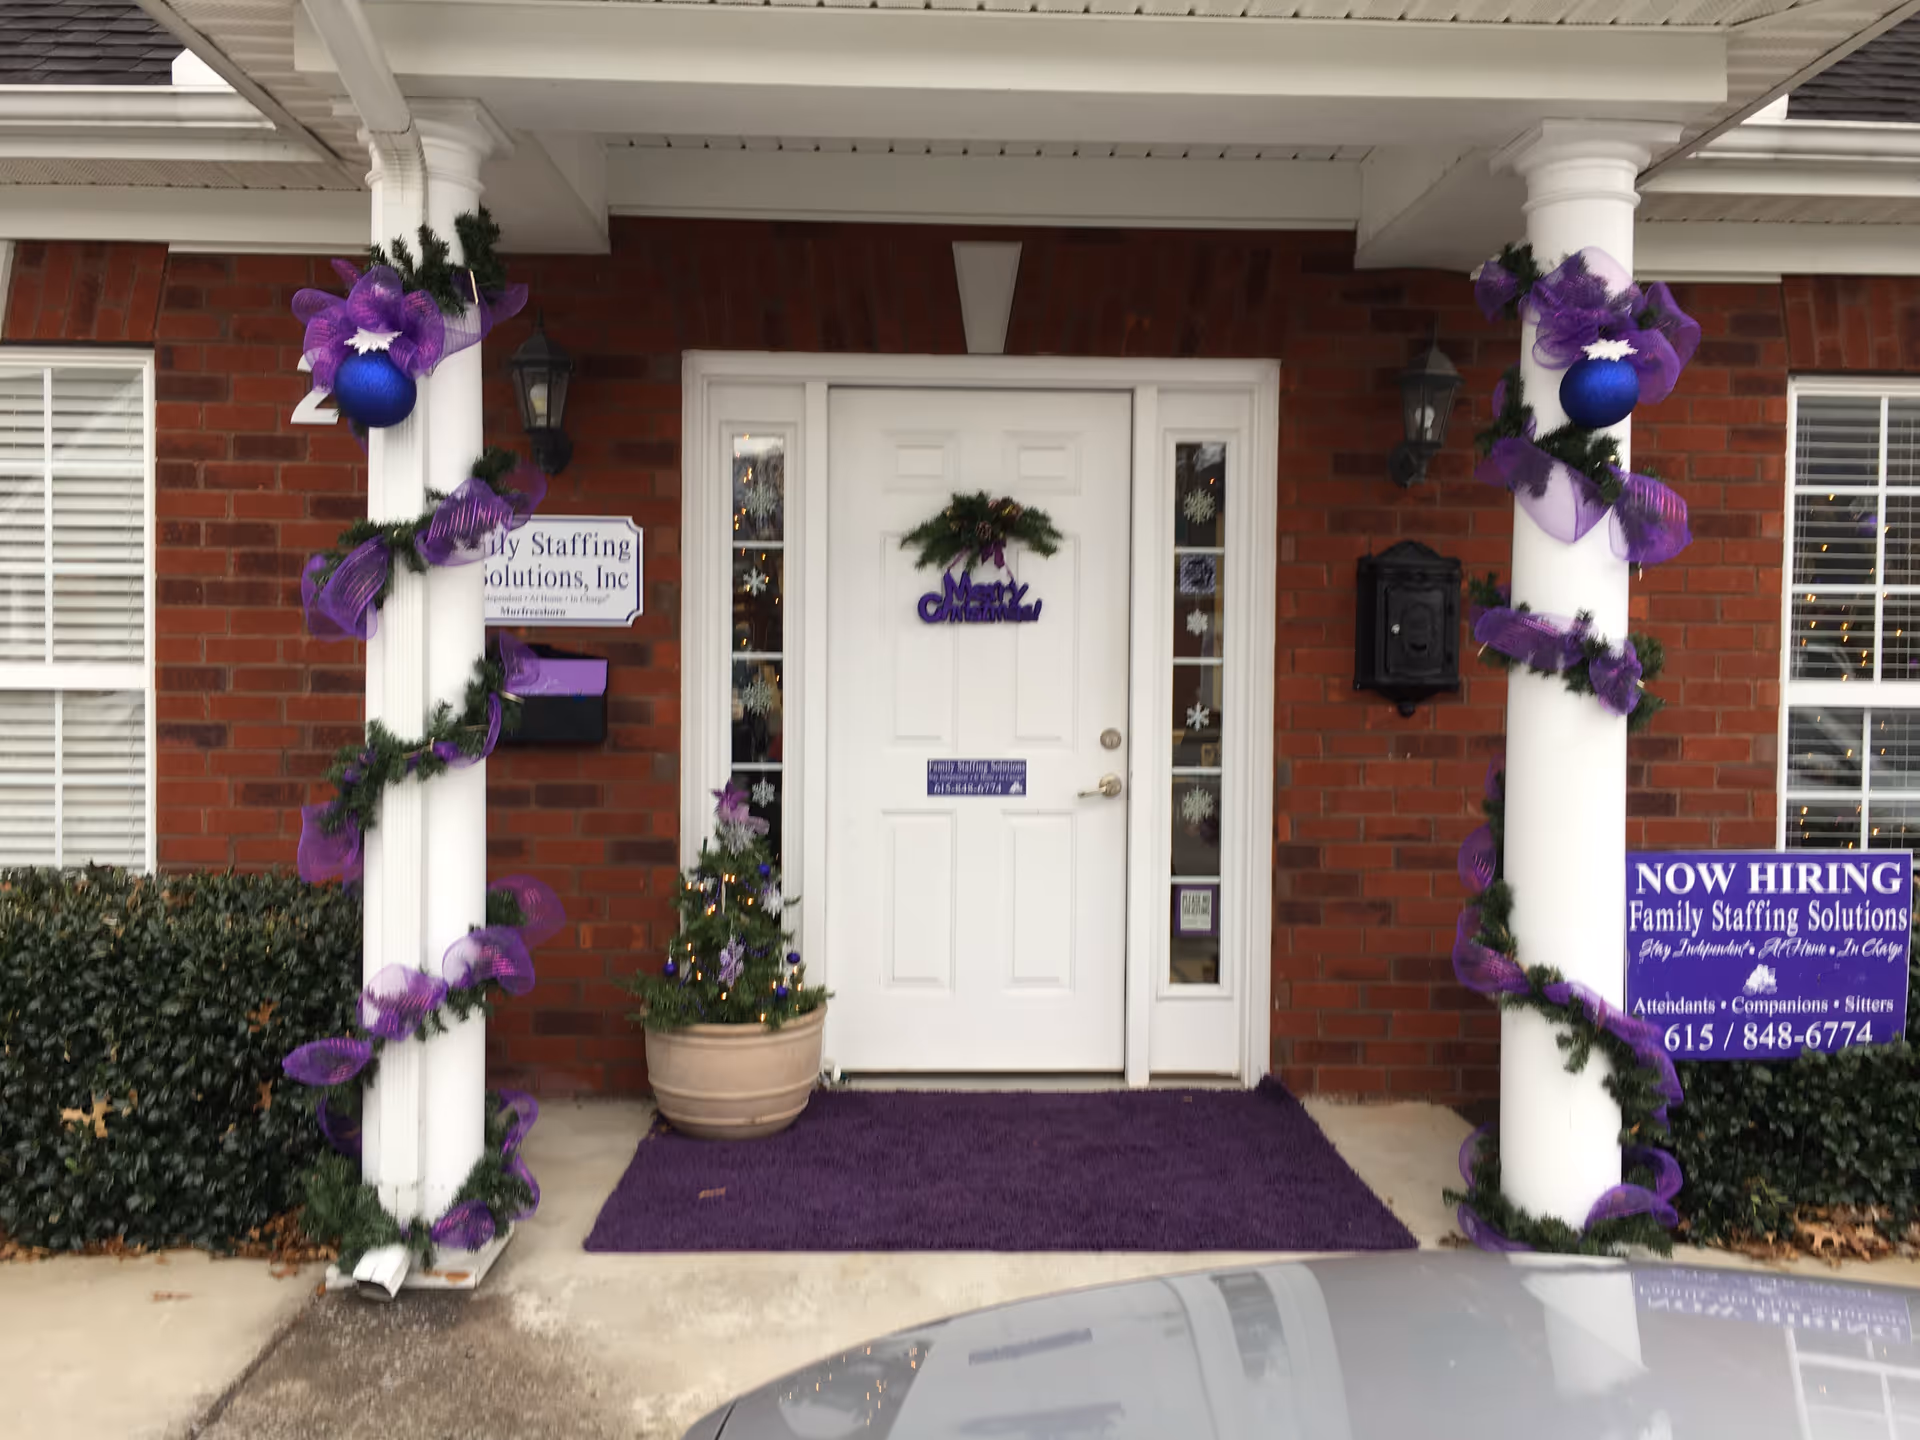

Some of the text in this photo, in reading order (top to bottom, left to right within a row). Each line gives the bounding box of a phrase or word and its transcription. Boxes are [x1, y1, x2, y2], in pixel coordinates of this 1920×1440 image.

[531, 531, 631, 562] Staffing
[484, 563, 629, 592] olutions, Inc
[1635, 862, 1903, 894] NOW HIRING
[1629, 899, 1908, 938] Family Staffing Solutions
[1639, 938, 1671, 962] Stay
[1672, 938, 1750, 961] Independent
[1837, 937, 1859, 960] In
[1861, 937, 1903, 963] Charge
[1633, 995, 1894, 1017] Attendants Companions Sitters
[1664, 1023, 1714, 1051] 615
[1743, 1020, 1873, 1050] 848-6774
